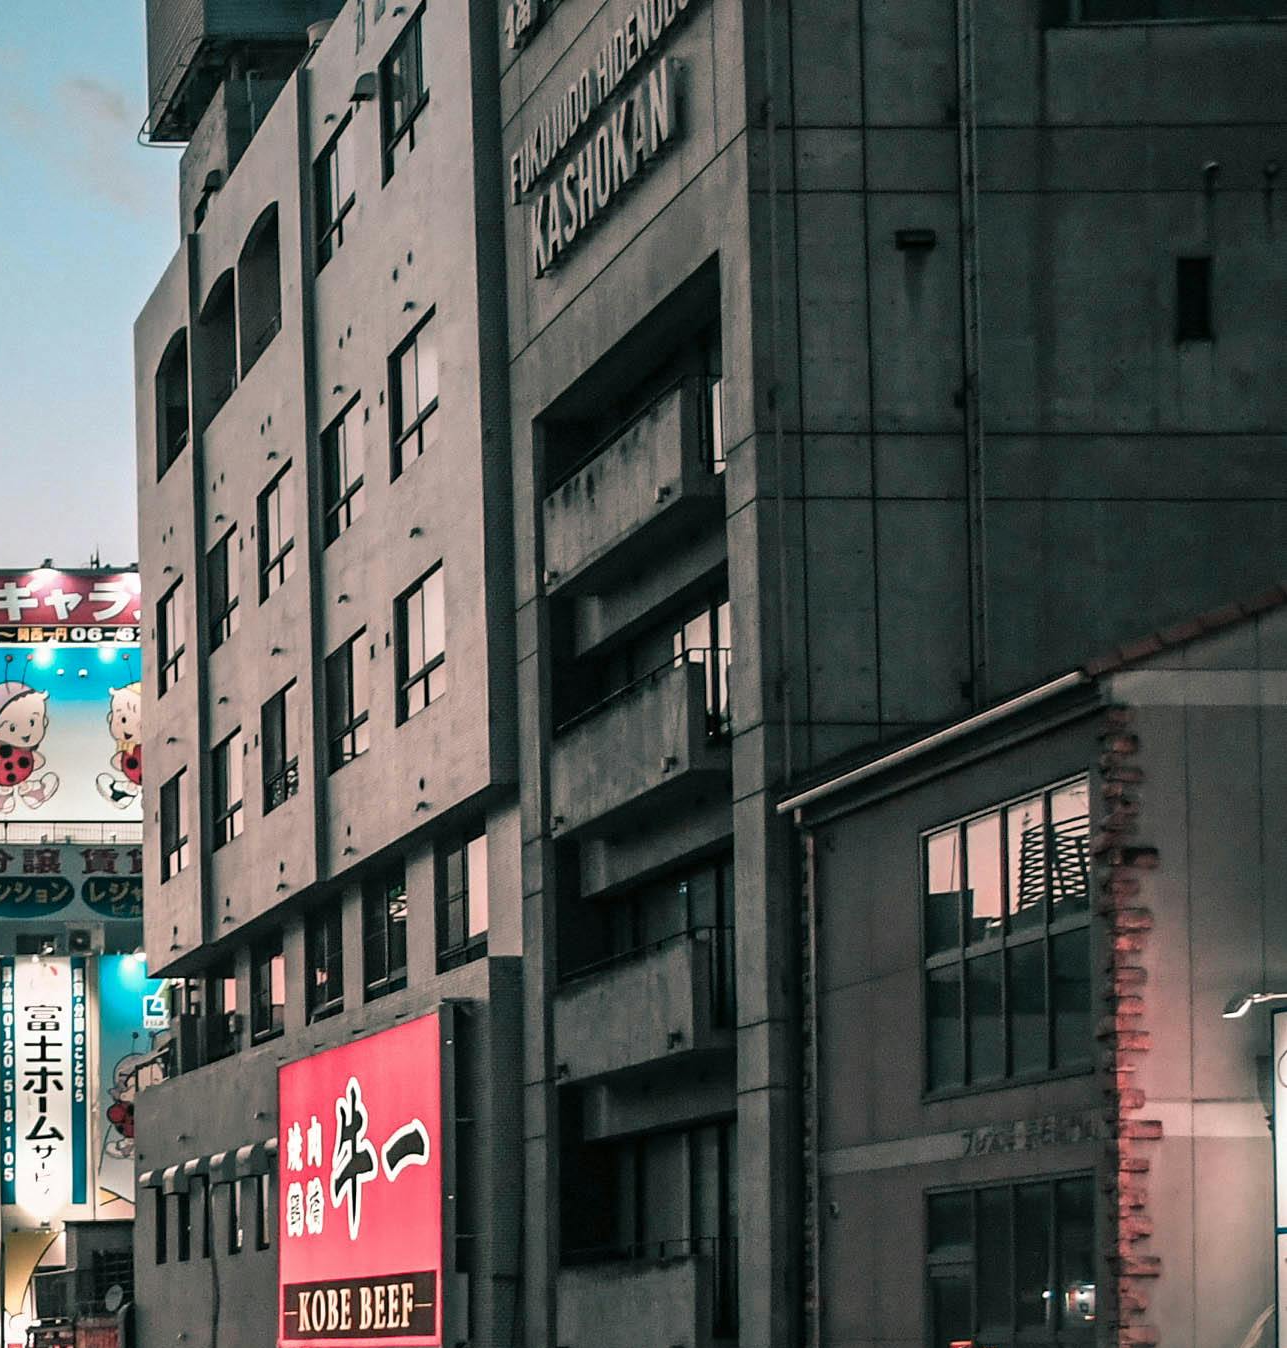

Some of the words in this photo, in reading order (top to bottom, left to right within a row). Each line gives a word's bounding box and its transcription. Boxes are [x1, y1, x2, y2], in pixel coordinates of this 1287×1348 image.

[510, 66, 591, 206] FUKUJUDO
[531, 56, 670, 278] KASHOKAN
[297, 1288, 352, 1333] KOBE
[359, 1282, 414, 1331] BEEF
